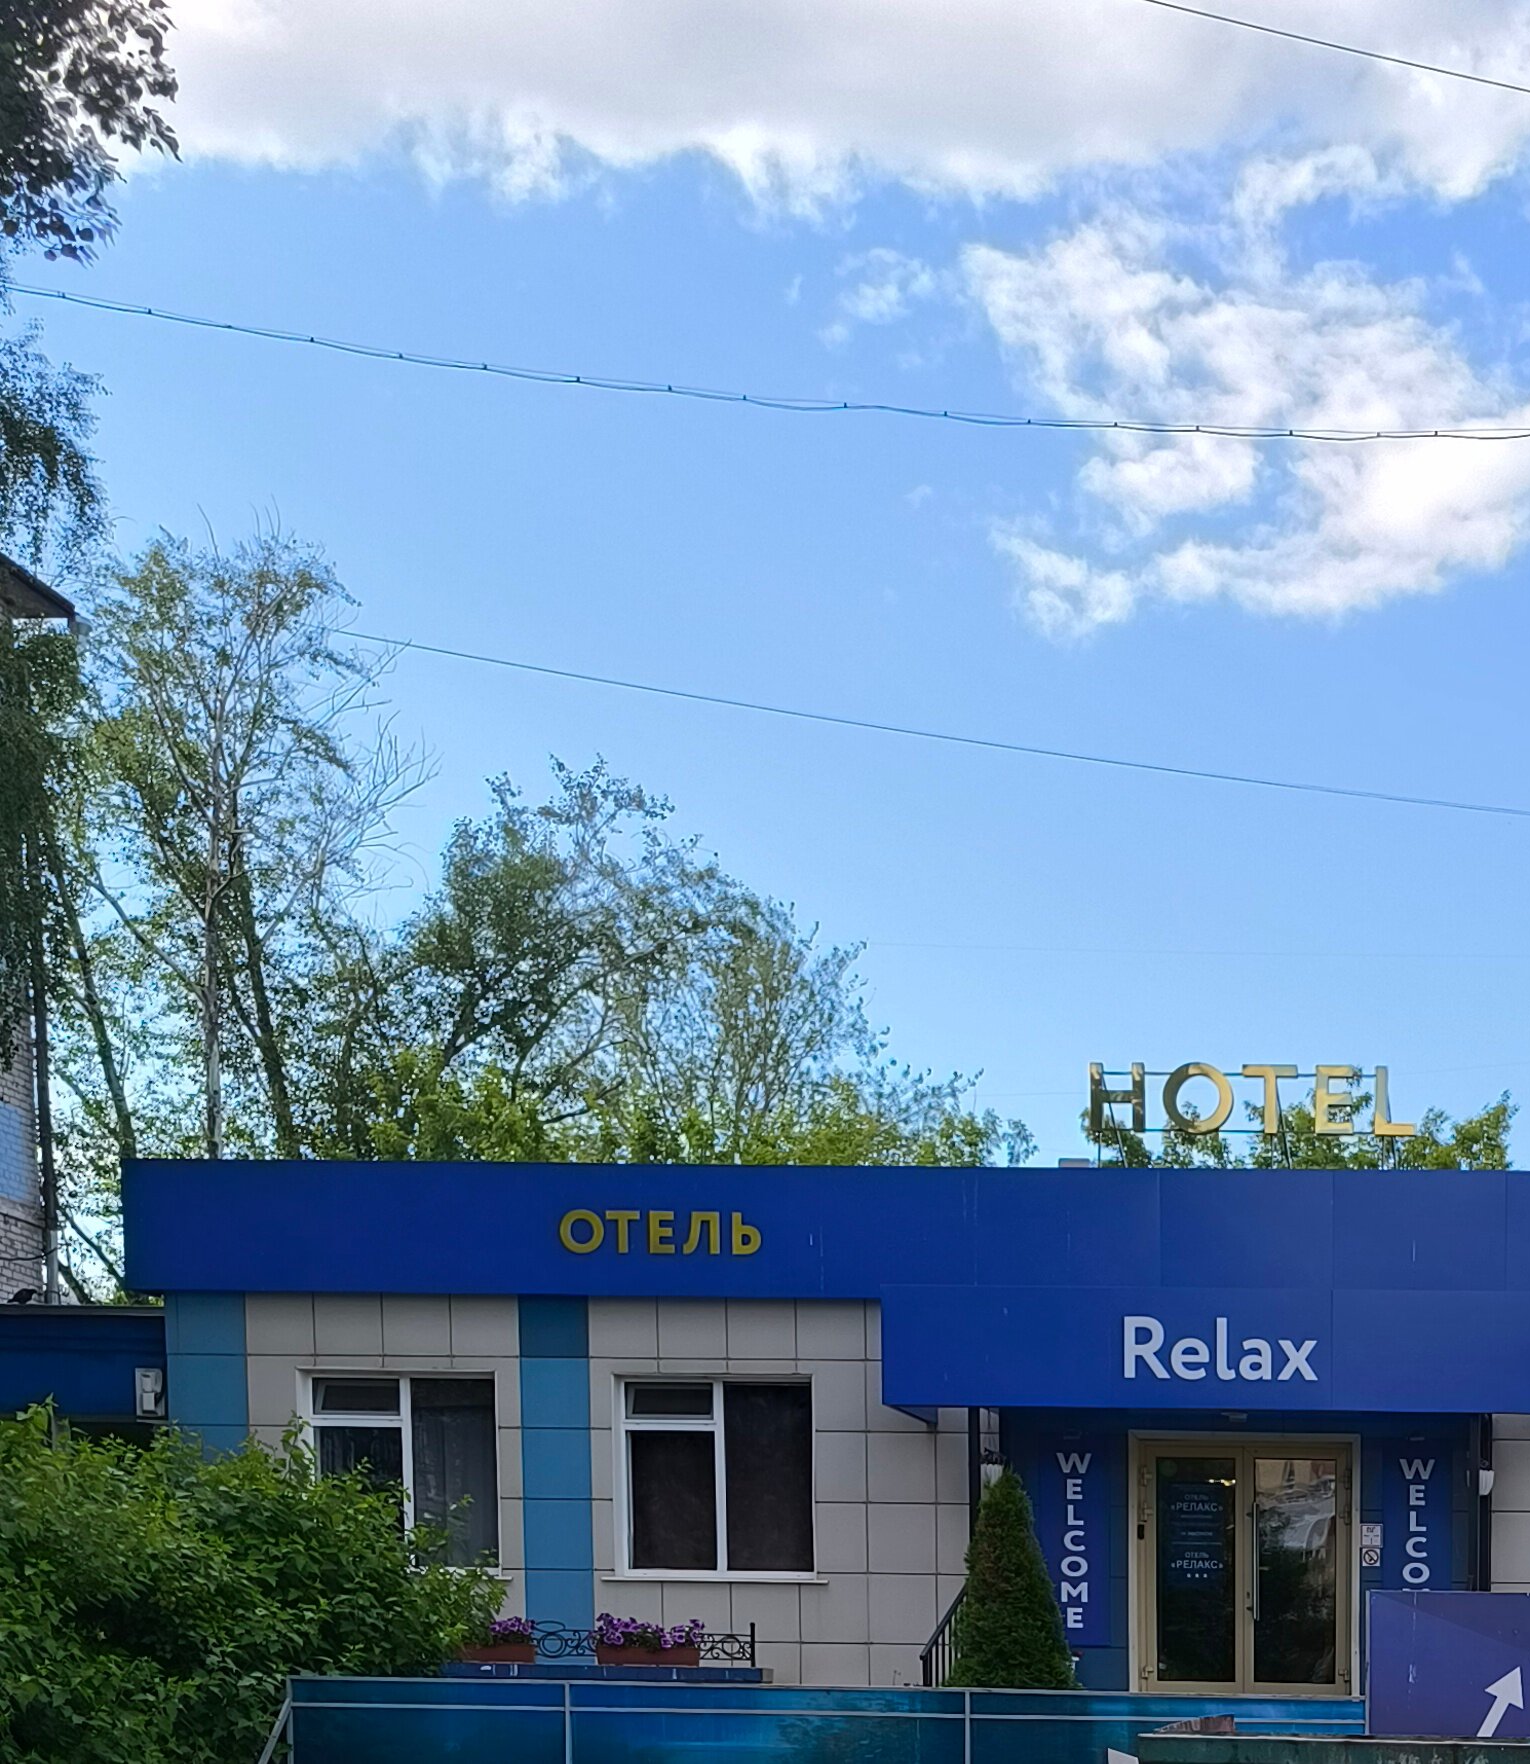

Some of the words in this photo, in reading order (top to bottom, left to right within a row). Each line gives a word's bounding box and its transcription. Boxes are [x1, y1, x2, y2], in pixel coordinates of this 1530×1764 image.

[1089, 1062, 1416, 1136] HOTEL
[559, 1208, 762, 1255] ОТЕЛЬ
[1122, 1315, 1319, 1382] Relax
[1057, 1452, 1092, 1629] WELCOME
[1399, 1458, 1435, 1591] WELCO
